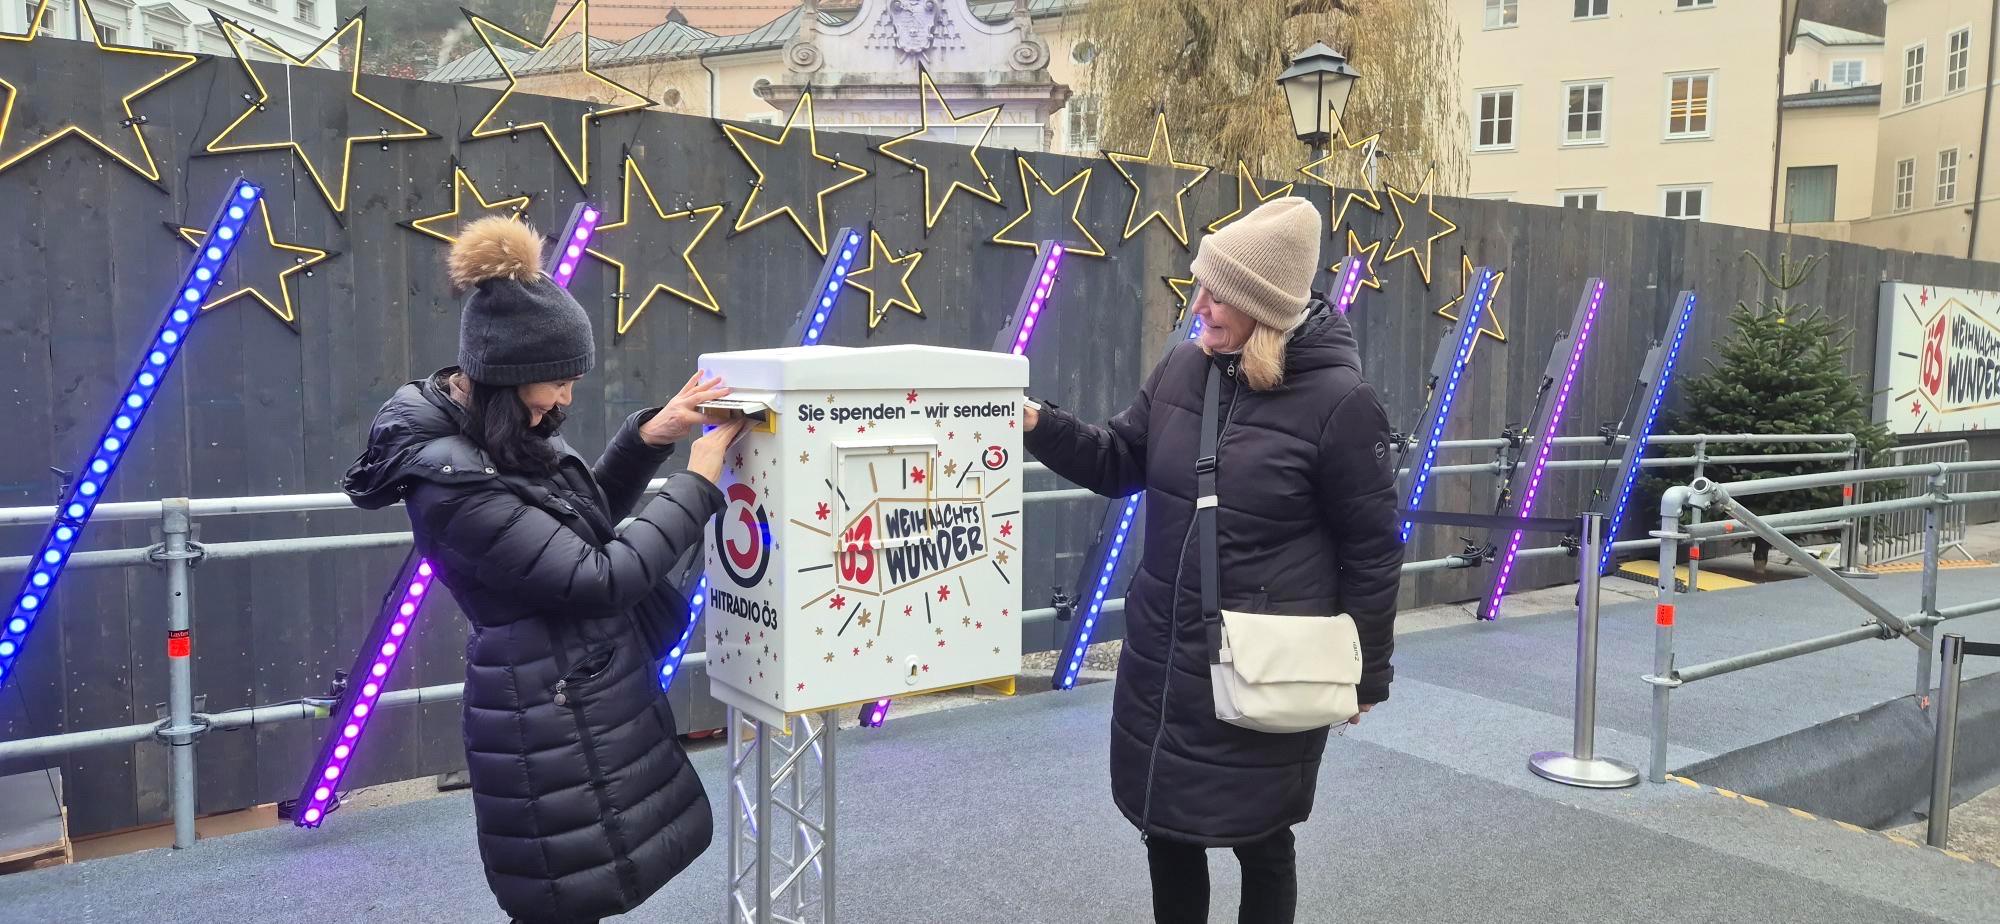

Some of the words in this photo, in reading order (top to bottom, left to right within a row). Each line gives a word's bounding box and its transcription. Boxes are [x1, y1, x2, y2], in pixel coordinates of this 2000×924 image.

[1923, 314, 1946, 396] Ö3
[1947, 352, 2000, 404] WUNDER
[798, 403, 825, 421] Sie
[830, 403, 906, 424] spenden
[925, 402, 950, 418] wir
[953, 401, 1015, 418] senden!
[885, 503, 980, 539] WEIHNACHTS
[839, 515, 875, 585] Ö3
[885, 525, 984, 585] WUNDER
[710, 588, 760, 623] HITRADIO
[762, 600, 778, 630] Ö3
